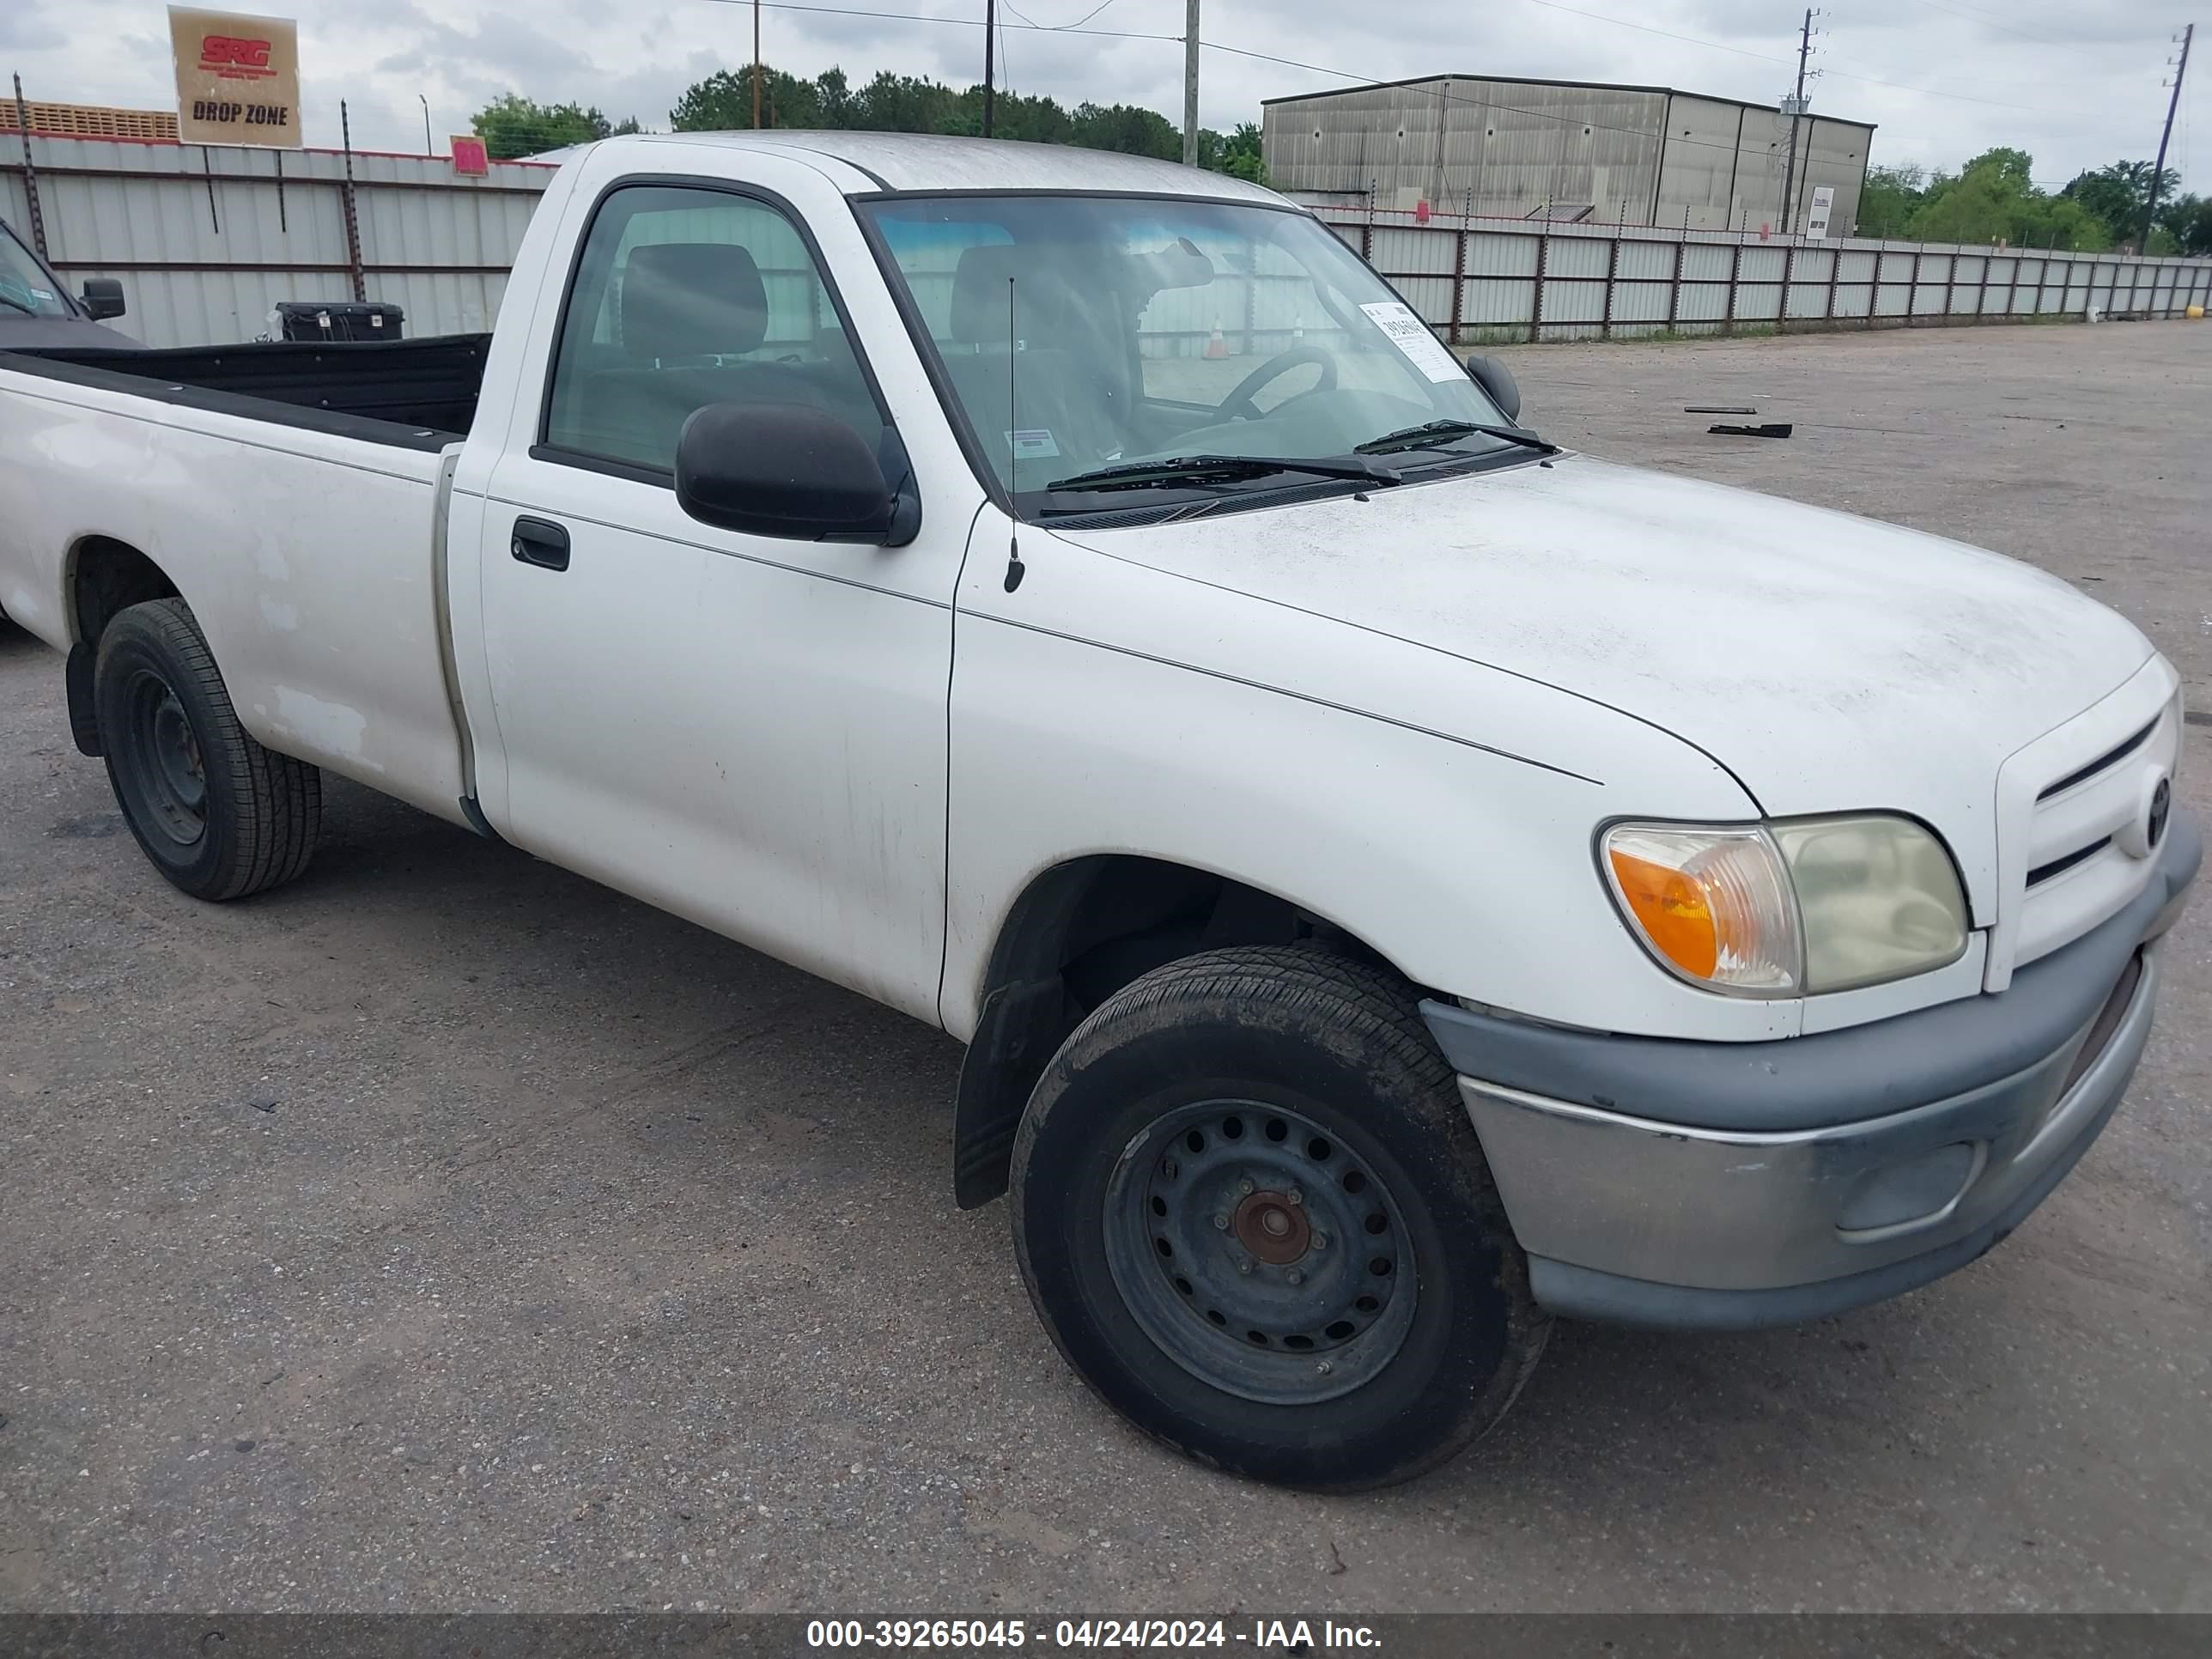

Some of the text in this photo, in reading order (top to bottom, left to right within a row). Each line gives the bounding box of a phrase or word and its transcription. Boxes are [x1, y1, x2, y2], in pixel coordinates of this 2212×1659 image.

[201, 36, 271, 66] SRG
[193, 100, 289, 126] DROP ZONE
